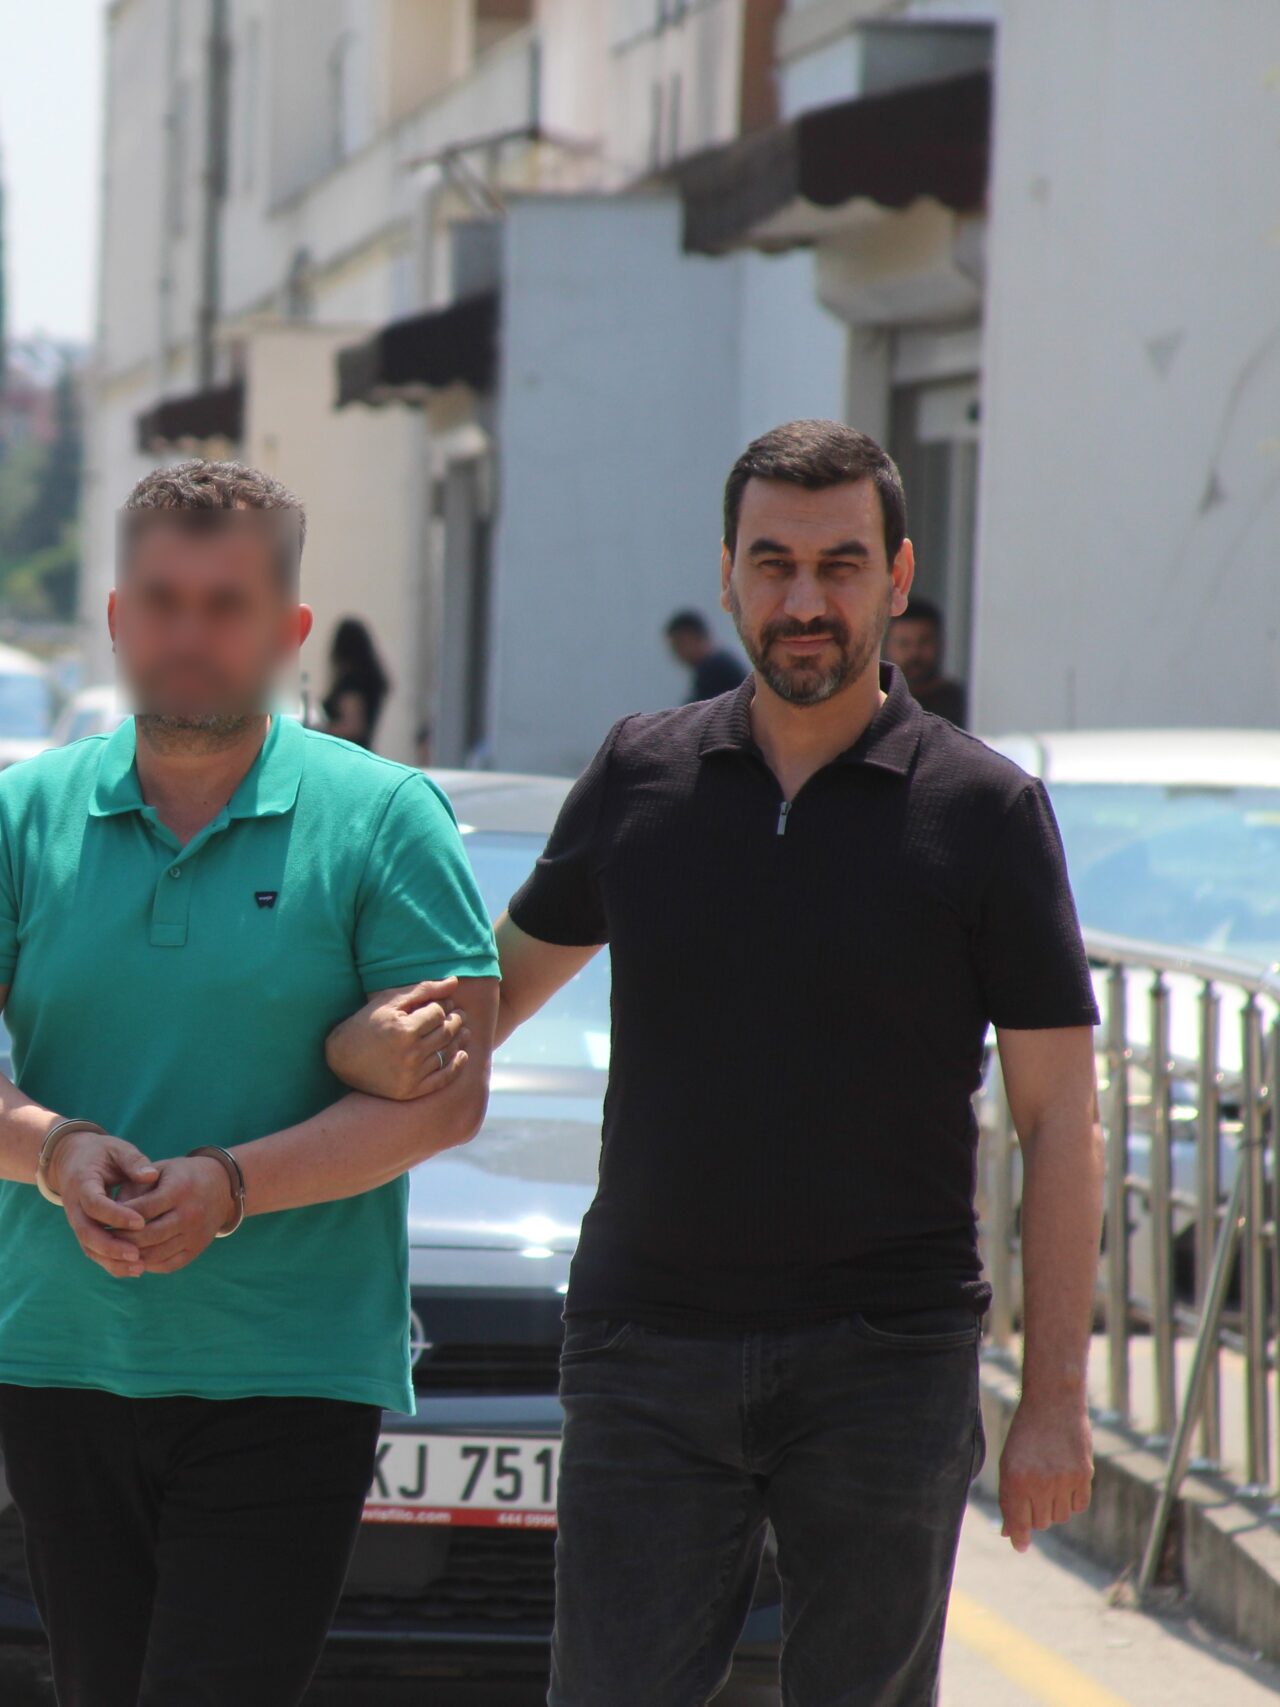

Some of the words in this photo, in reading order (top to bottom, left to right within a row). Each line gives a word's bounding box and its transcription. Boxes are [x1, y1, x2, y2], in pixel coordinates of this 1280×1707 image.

[367, 1444, 428, 1500] KJ
[460, 1446, 553, 1504] 751
[497, 1511, 522, 1526] 444
